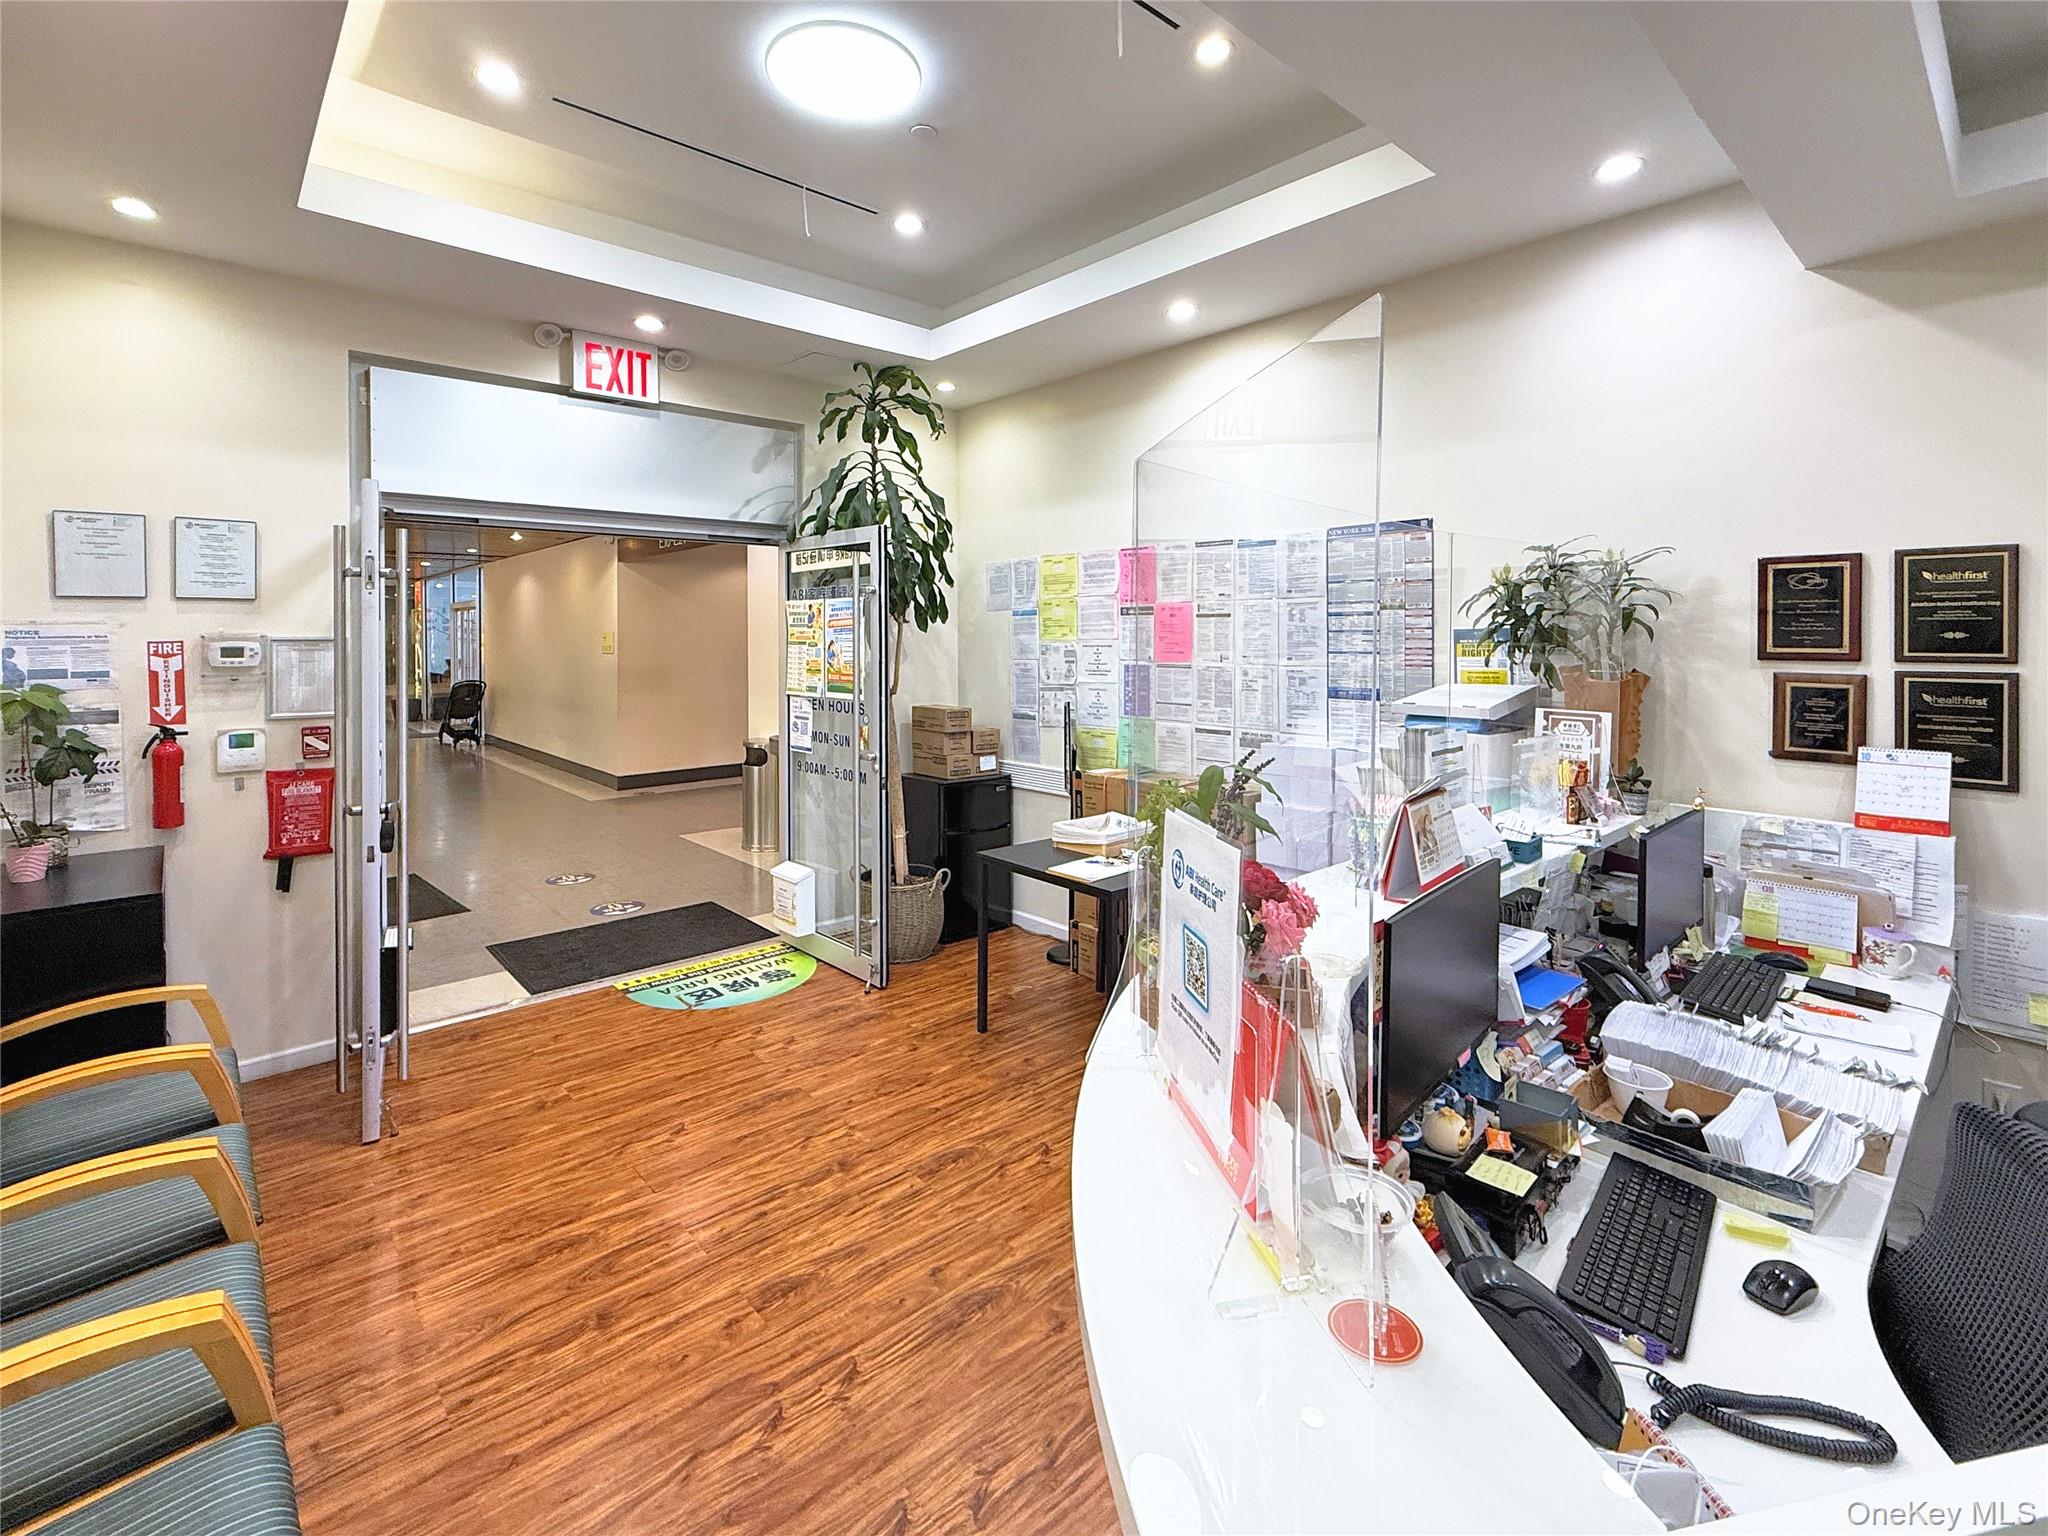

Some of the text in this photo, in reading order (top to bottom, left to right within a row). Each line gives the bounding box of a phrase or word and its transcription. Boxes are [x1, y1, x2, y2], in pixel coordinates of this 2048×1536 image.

[585, 342, 652, 397] EXIT
[1933, 571, 1988, 580] healthfirst
[149, 643, 182, 654] FIRE
[1461, 649, 1491, 657] RIGHTS
[163, 660, 171, 717] EXTINGUISHER
[1933, 694, 1988, 706] healthfirst
[812, 730, 850, 748] MON-SUN
[1861, 752, 1871, 761] 10
[797, 760, 867, 785] 9:00AM--5:00M
[713, 957, 794, 981] WAITING
[657, 979, 709, 995] AREA
